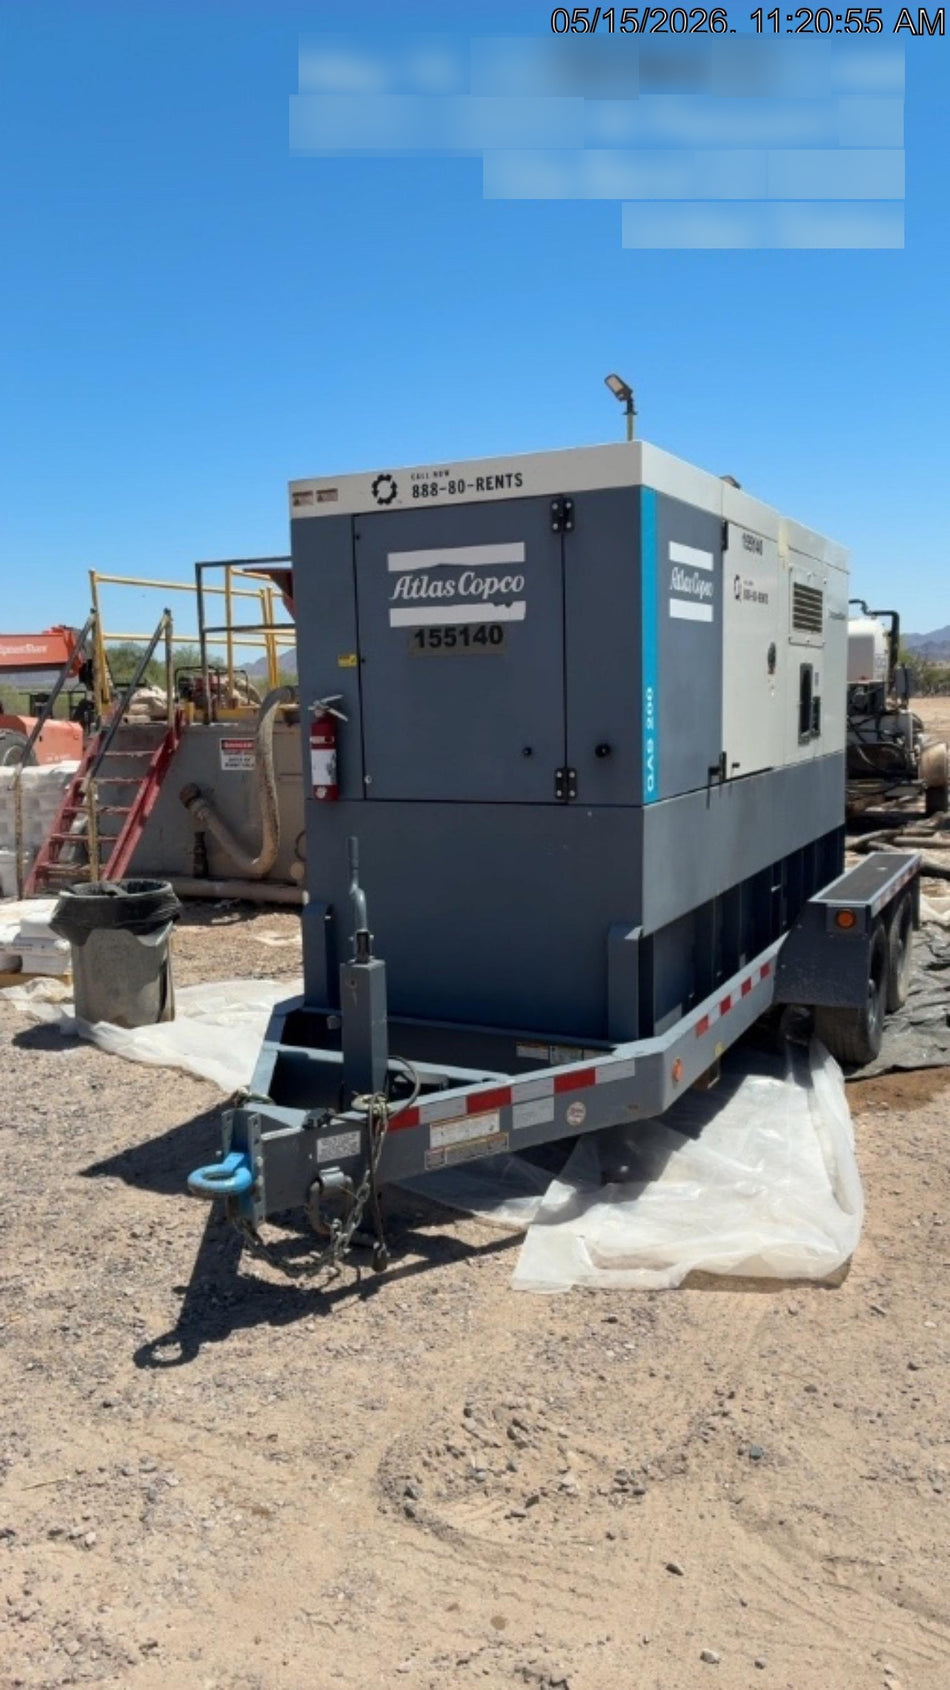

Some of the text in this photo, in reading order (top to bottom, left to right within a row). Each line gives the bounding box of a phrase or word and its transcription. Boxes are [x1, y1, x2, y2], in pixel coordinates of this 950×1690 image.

[411, 472, 429, 481] CALL
[412, 472, 524, 499] 888-80-RENTS
[389, 571, 526, 600] Atlas Copco
[413, 624, 505, 649] 155140
[645, 686, 655, 792] QAS 200
